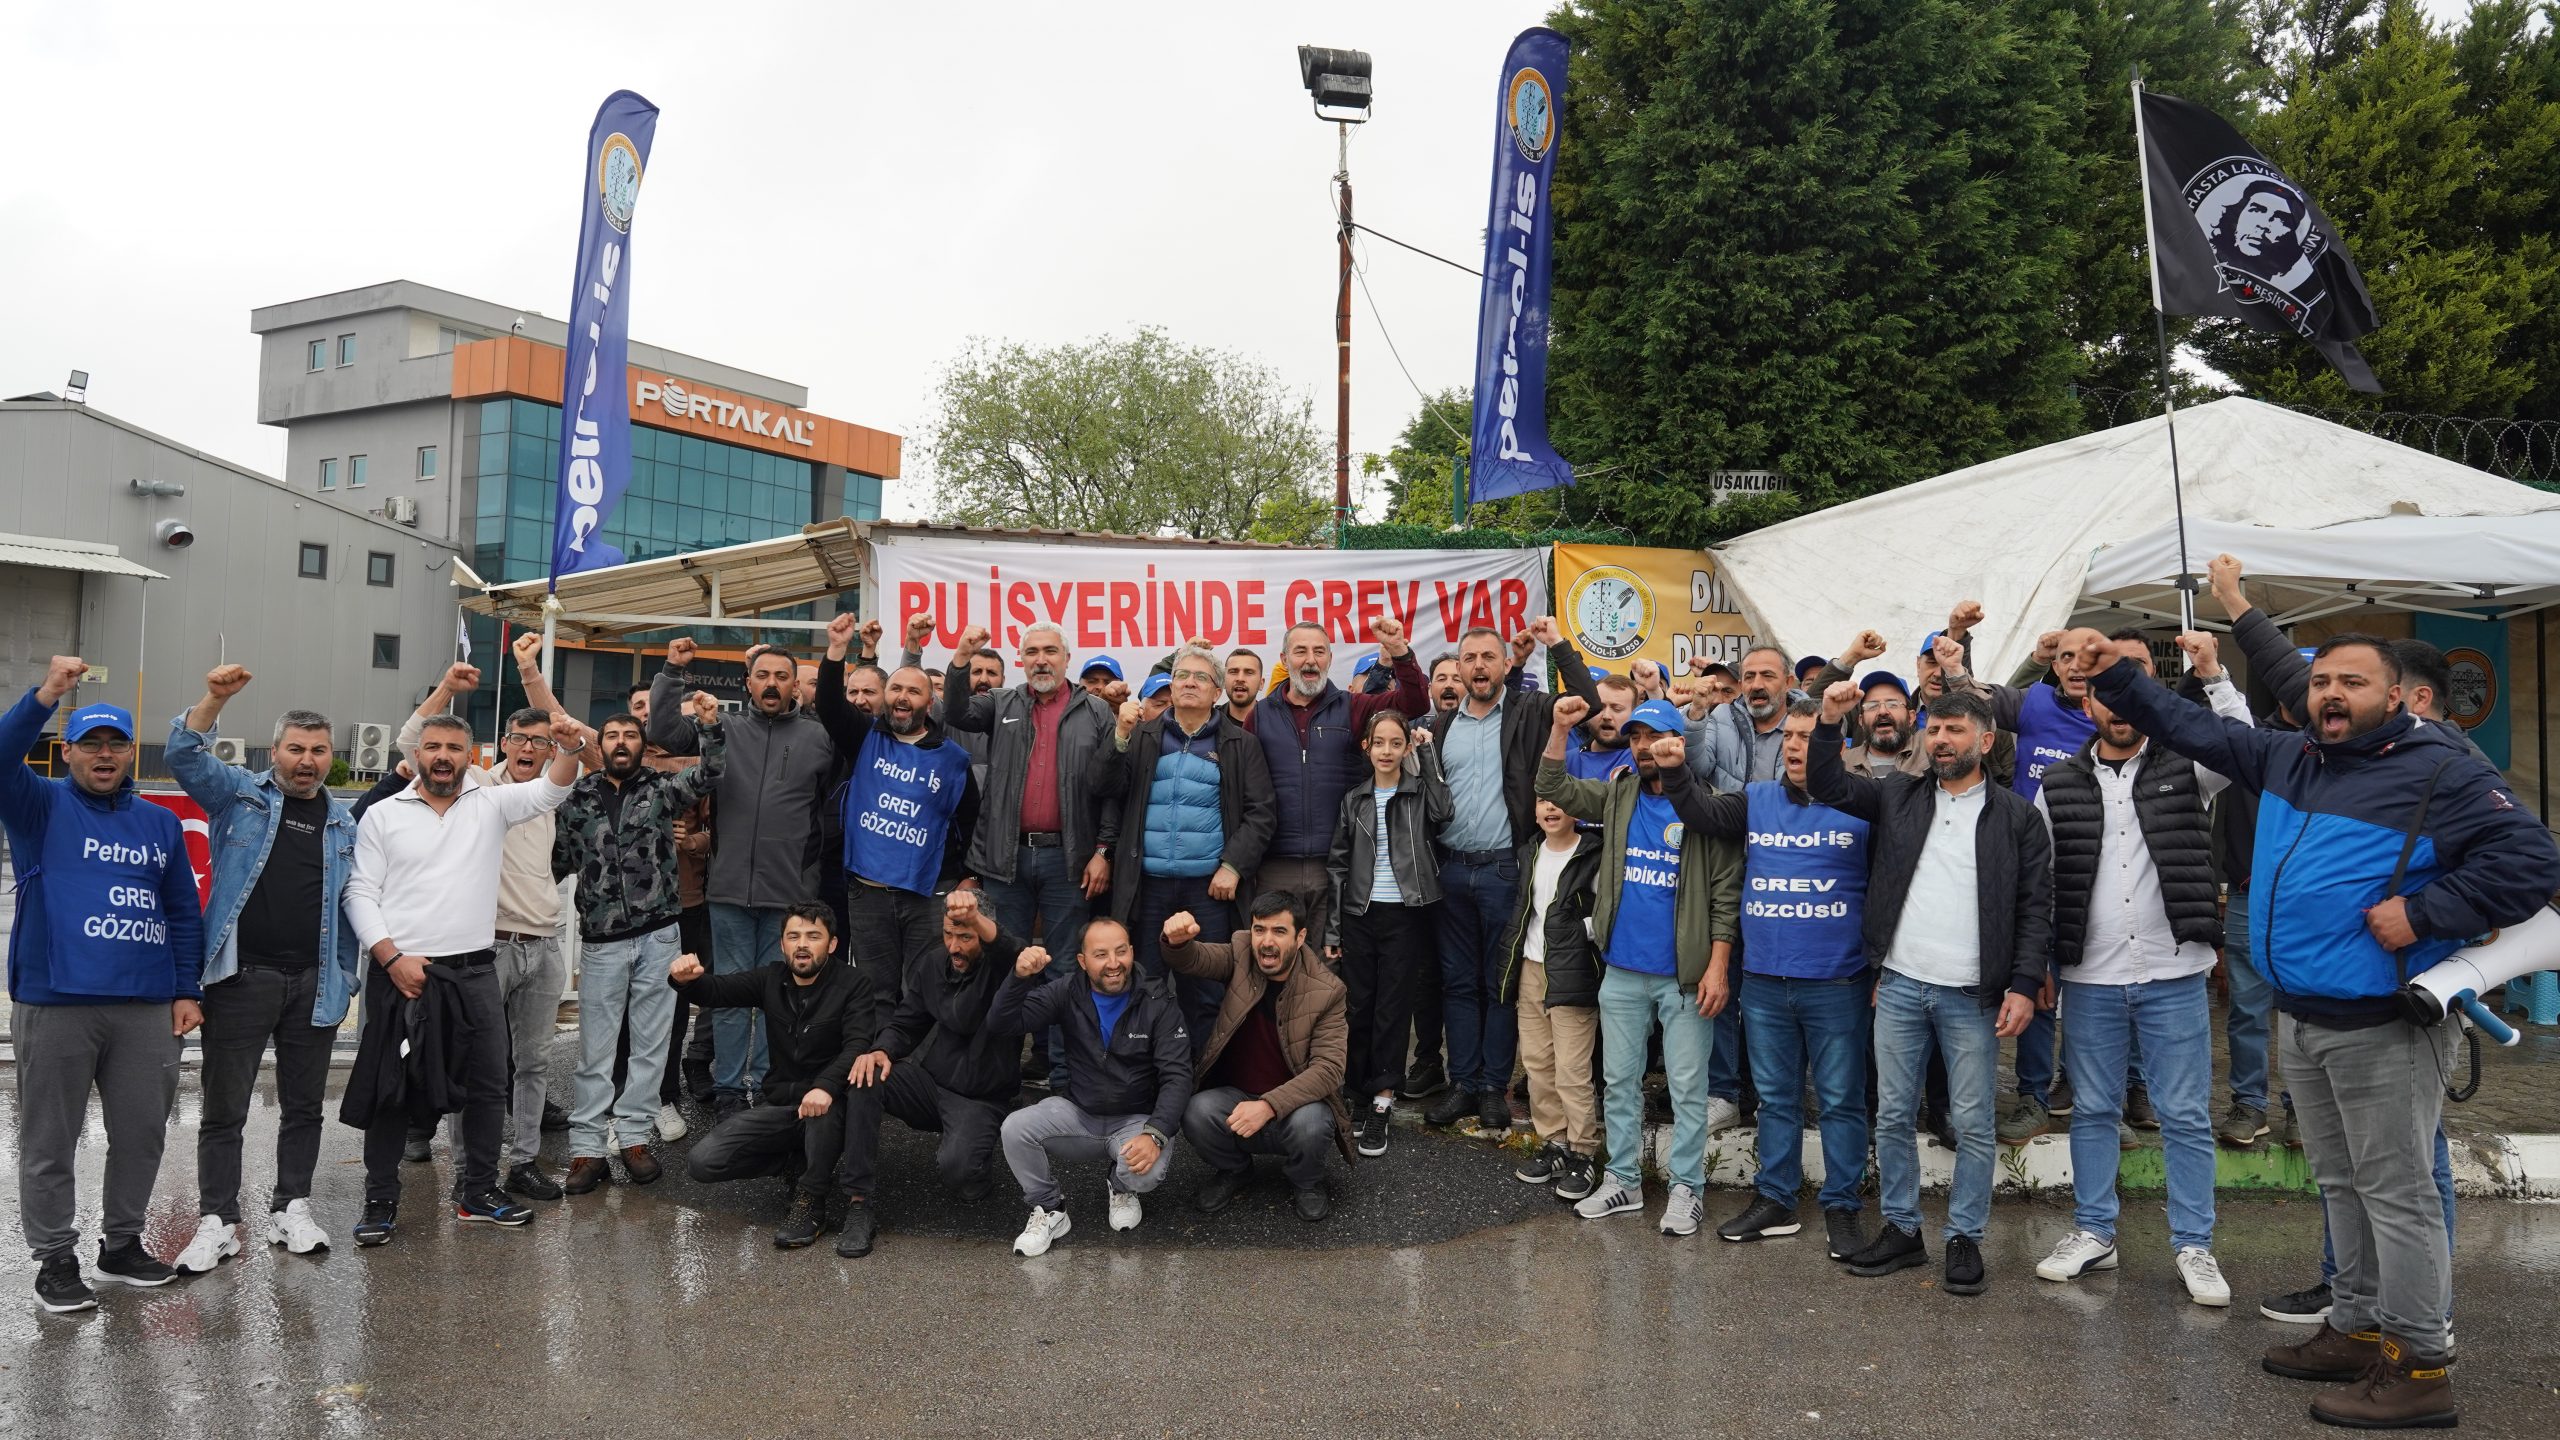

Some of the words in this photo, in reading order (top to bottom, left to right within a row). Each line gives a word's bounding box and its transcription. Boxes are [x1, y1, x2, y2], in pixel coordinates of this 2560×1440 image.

[2186, 169, 2229, 209] HASTA
[2231, 163, 2251, 174] LA
[636, 379, 814, 446] PORTAKAL
[900, 581, 969, 650] BU
[989, 564, 1268, 668] İŞYERİNDE
[1284, 580, 1421, 644] GREV
[1434, 579, 1529, 644] VAR
[1580, 635, 1617, 658] PETROL-İŞ
[1622, 640, 1640, 654] 1950
[684, 671, 741, 687] ORTAKAL
[878, 793, 921, 818] GREV
[860, 811, 928, 847] GÖZCÜSÜ
[1748, 831, 1854, 848] petrol-iş
[1626, 847, 1680, 865] etrol-iş
[1751, 877, 1837, 892] GREV
[109, 886, 156, 910] GREV
[1746, 901, 1848, 919] GÖZCÜSÜ
[83, 913, 166, 945] GÖZCÜSÜ
[2384, 1341, 2398, 1357] CAT
